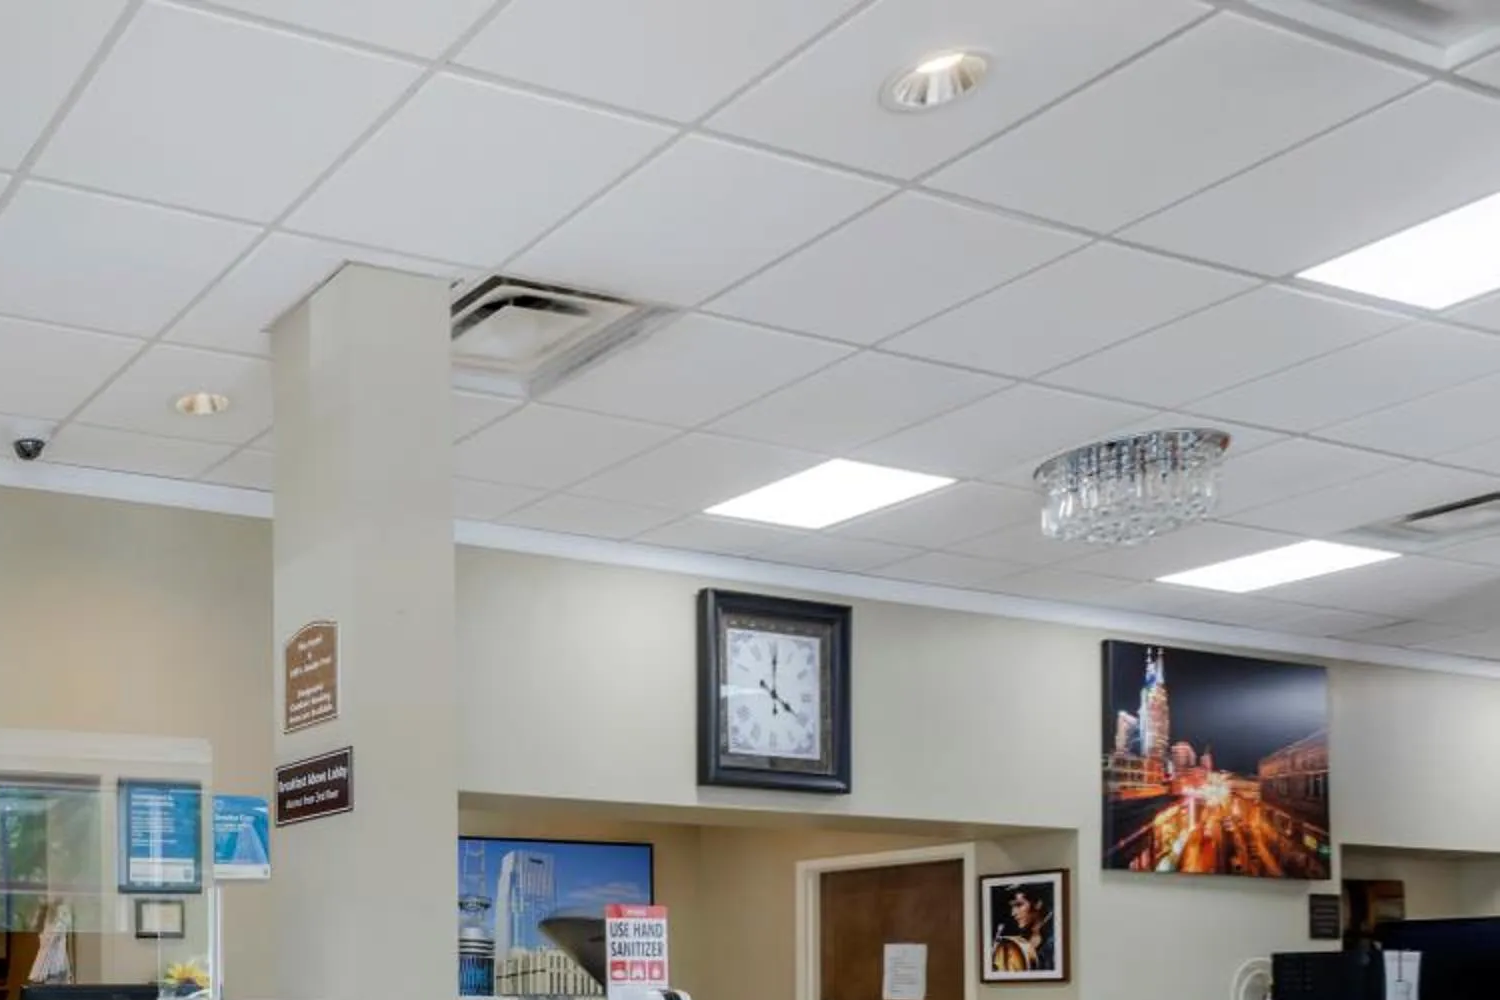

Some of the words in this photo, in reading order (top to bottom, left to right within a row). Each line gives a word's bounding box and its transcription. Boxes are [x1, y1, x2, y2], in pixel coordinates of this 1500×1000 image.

[610, 922, 629, 938] USE
[633, 922, 664, 938] HAND
[611, 941, 664, 957] SANITIZER
